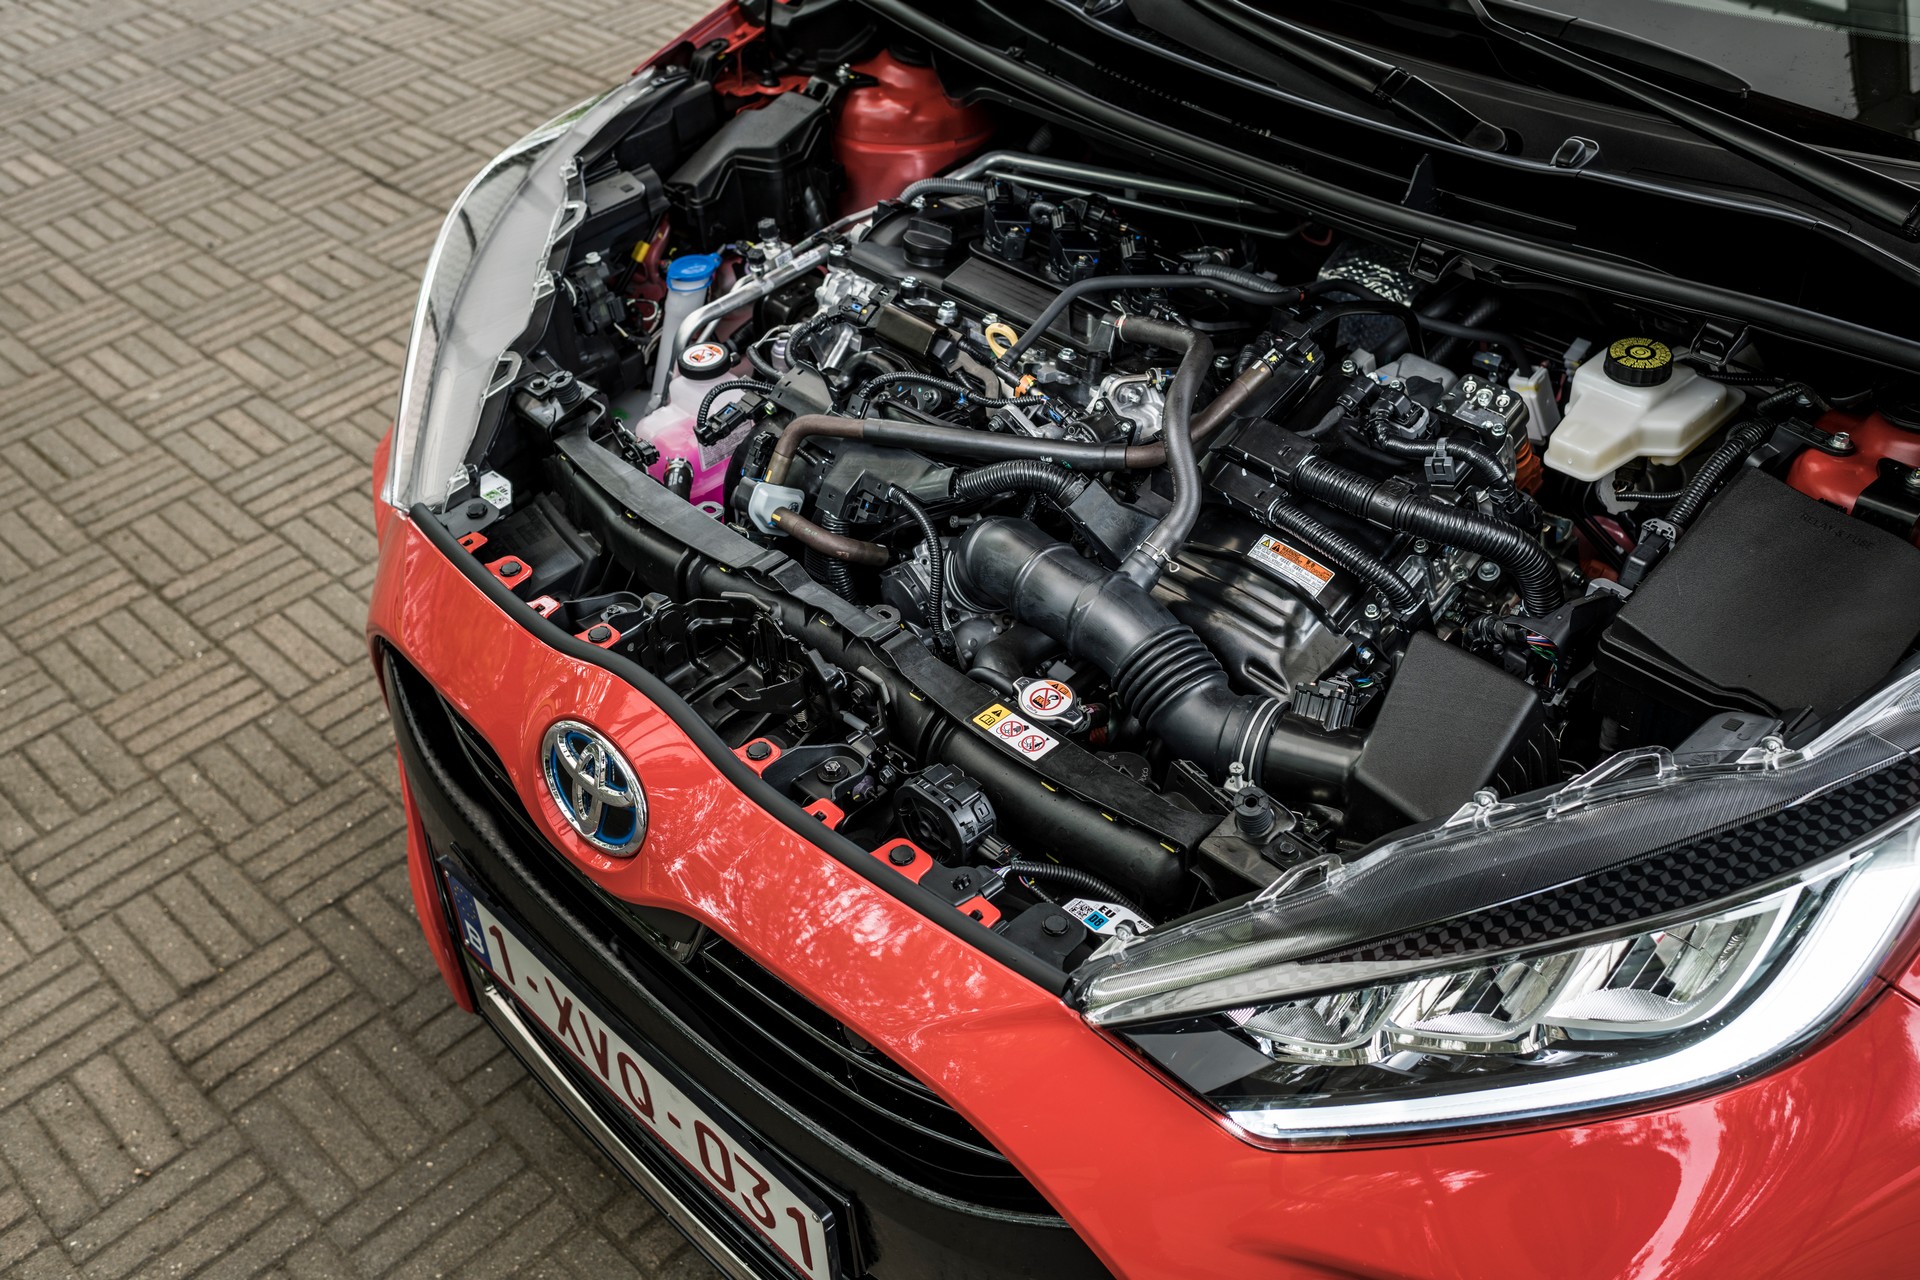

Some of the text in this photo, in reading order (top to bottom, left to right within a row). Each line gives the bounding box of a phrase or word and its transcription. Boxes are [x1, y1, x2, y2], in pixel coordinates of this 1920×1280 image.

[1801, 513, 1834, 531] RELAY
[1846, 532, 1875, 549] FUSE
[1088, 914, 1104, 926] D8
[1098, 905, 1116, 918] EU
[465, 920, 485, 954] B
[489, 925, 813, 1271] 1-XVQ-031
